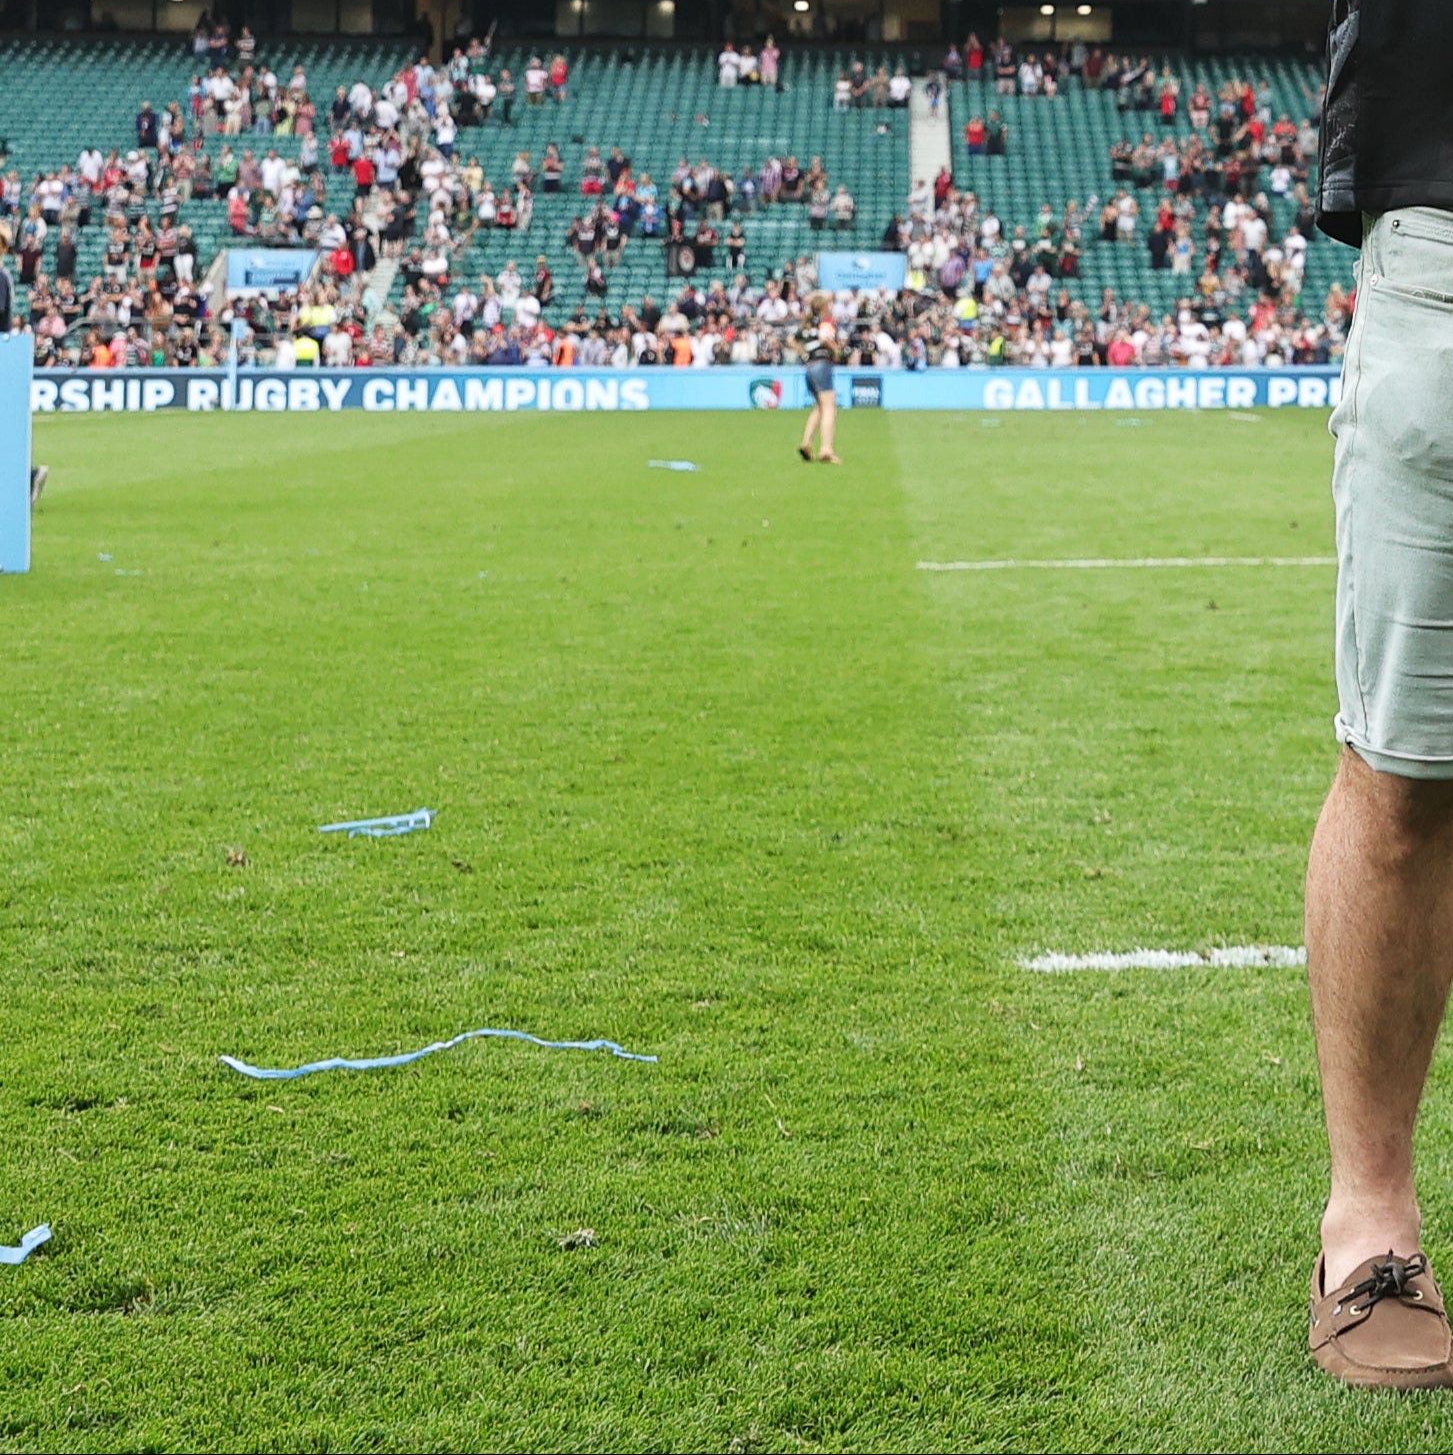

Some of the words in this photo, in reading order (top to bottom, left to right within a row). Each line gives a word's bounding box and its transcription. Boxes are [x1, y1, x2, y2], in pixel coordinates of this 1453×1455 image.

[187, 378, 352, 413] RUGBY
[362, 377, 651, 413] CHAMPIONS
[983, 377, 1258, 410] GALLAGHER
